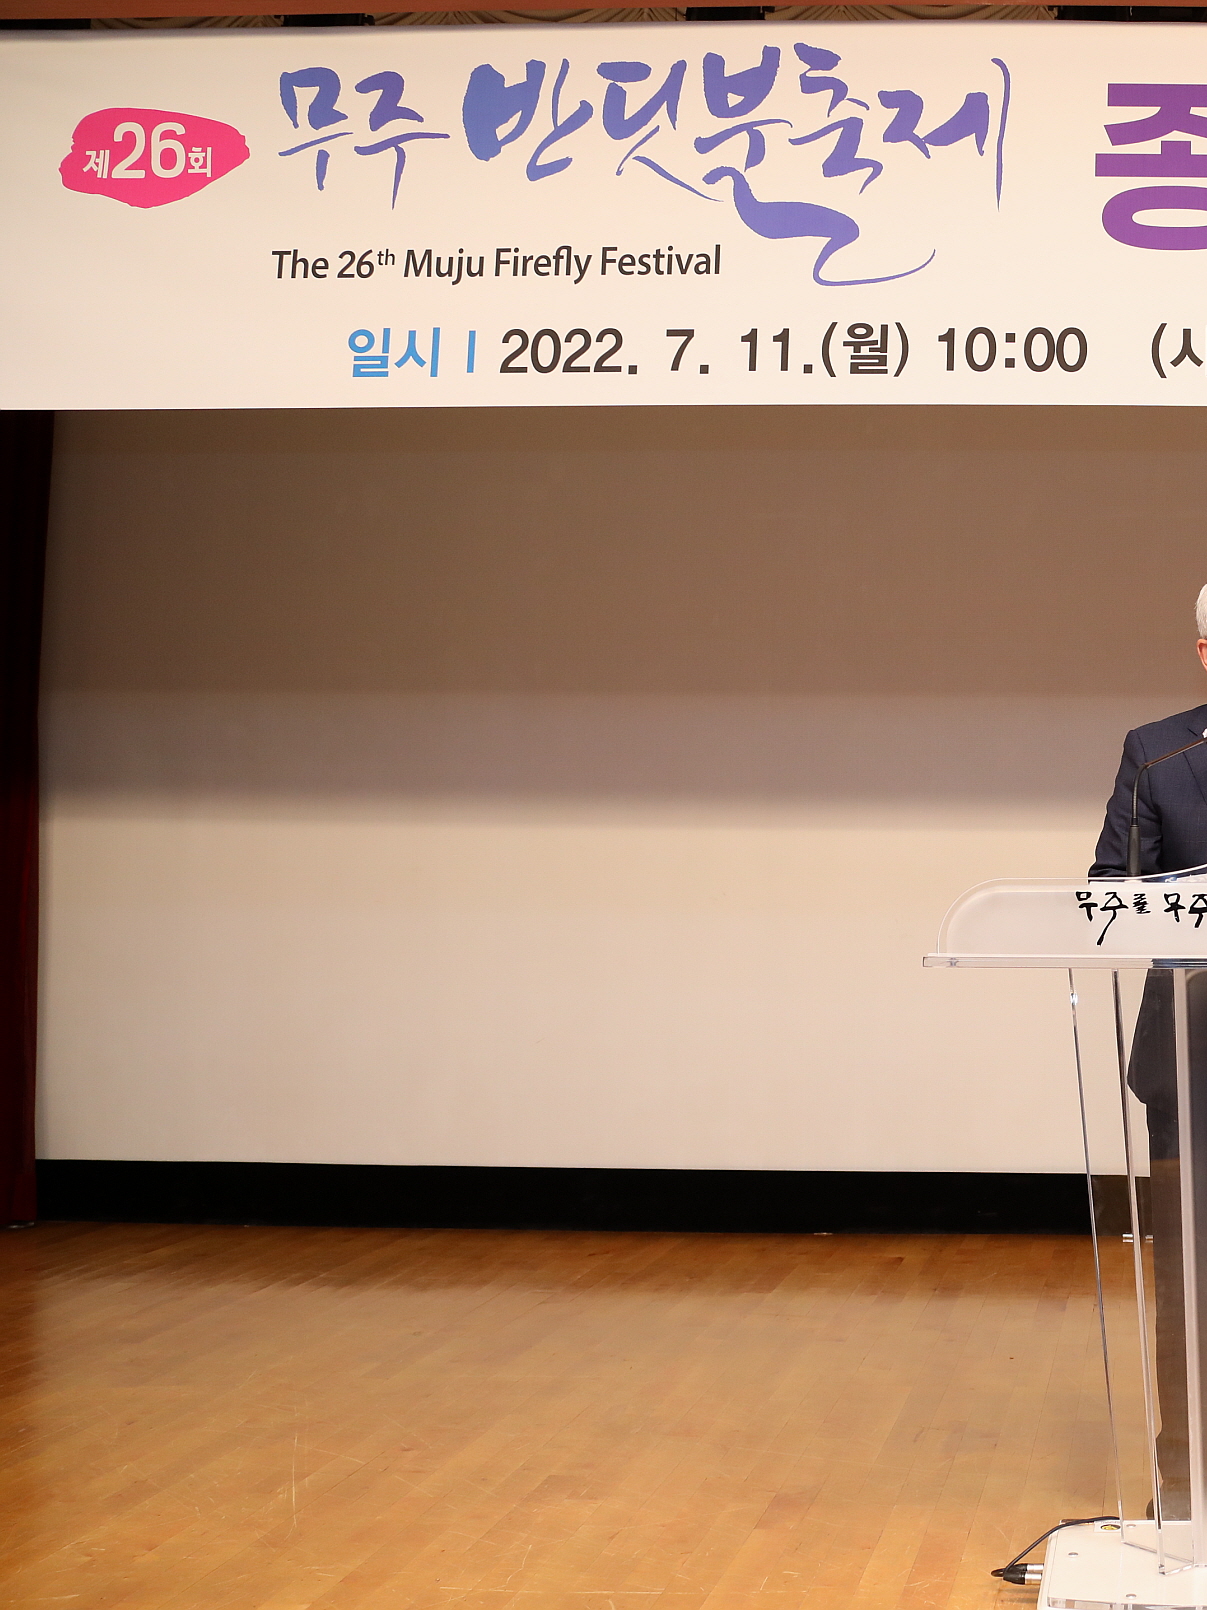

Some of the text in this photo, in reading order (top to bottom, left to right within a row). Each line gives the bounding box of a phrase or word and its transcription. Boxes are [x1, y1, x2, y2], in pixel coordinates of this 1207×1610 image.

[83, 122, 213, 179] 제26회
[278, 42, 1010, 286] 무주 반딧불축제
[272, 244, 721, 285] The 26th Muju Firefly Festival
[348, 327, 440, 377] 일시
[500, 328, 637, 374] 2022.
[666, 329, 709, 374] 7.
[938, 327, 1087, 372] 10:00
[1076, 891, 1151, 946] 무주를
